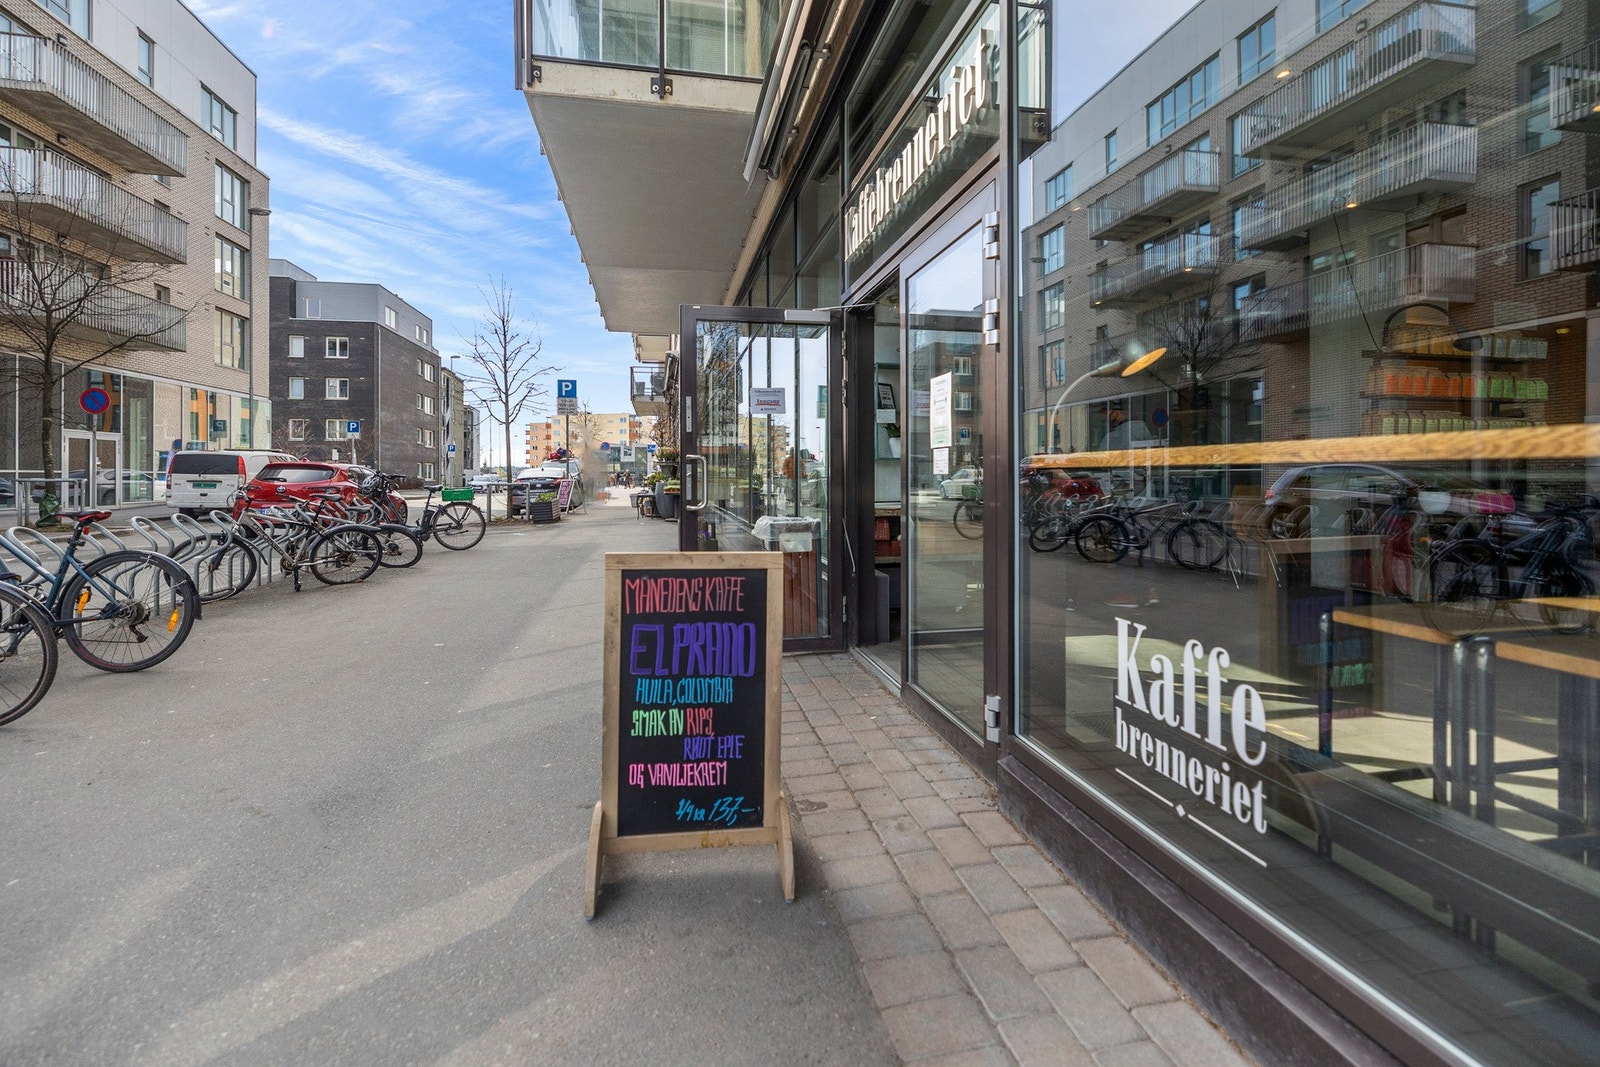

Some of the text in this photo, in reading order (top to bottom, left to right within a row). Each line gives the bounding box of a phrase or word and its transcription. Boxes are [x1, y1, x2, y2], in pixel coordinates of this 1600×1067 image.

[844, 28, 993, 262] Kaffebrenneriet
[562, 381, 572, 396] P
[350, 422, 357, 431] P
[705, 576, 746, 612] KAFFE
[630, 622, 756, 677] EL PRADO
[1115, 617, 1267, 766] Kaffe
[631, 709, 667, 737] SMAK
[668, 708, 684, 736] AV
[629, 761, 727, 788] OG VANILJEKREM
[1115, 706, 1267, 834] brenneriet
